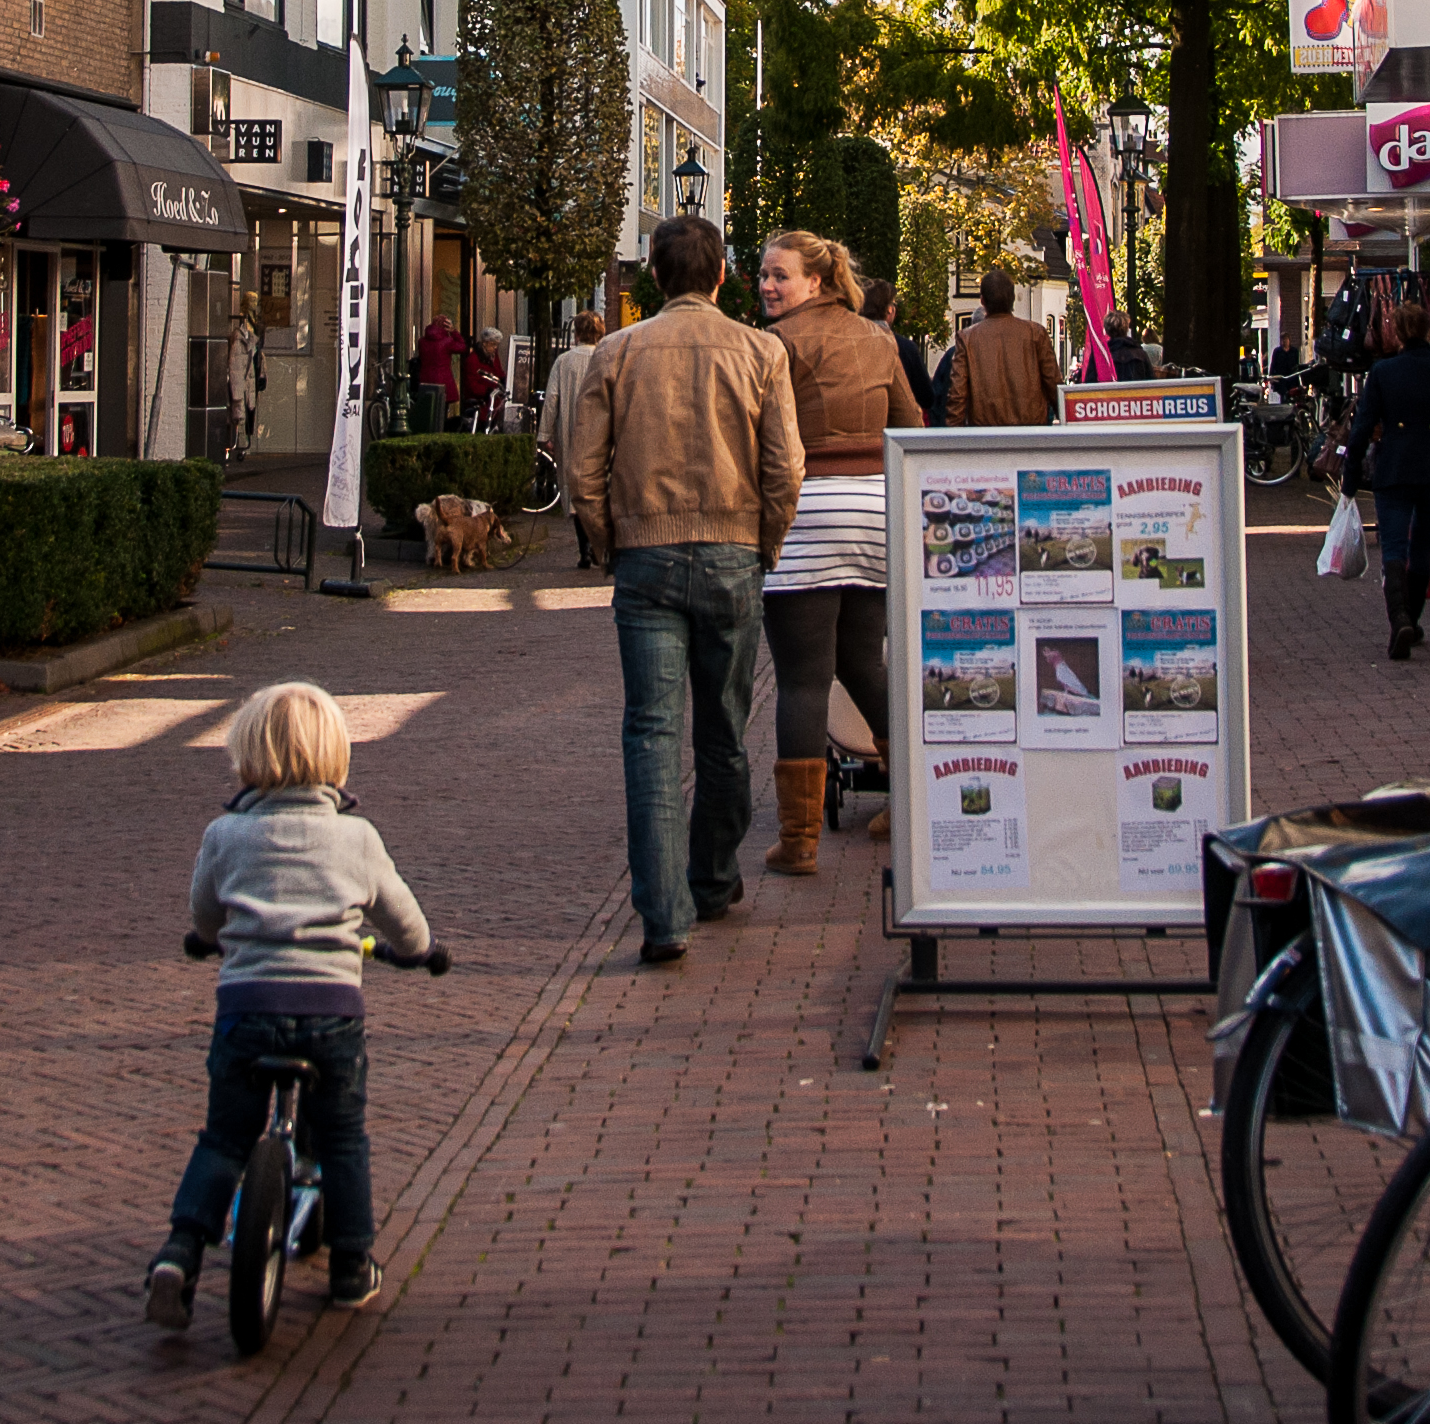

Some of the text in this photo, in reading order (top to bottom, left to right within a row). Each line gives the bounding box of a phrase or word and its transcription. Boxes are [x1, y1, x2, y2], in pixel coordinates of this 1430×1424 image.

[239, 124, 275, 133] VAN
[239, 136, 274, 146] VUU
[238, 148, 275, 158] REN
[1075, 398, 1208, 418] SCHOENENREUS
[1046, 476, 1107, 492] GRATIS
[1117, 477, 1203, 499] AANBIEDING
[974, 573, 1015, 600] 11,95
[950, 615, 1010, 632] GRATIS
[1151, 616, 1211, 631] GRATIS
[933, 757, 1018, 780] AANBIEDING
[1123, 758, 1209, 781] AANBIEDING
